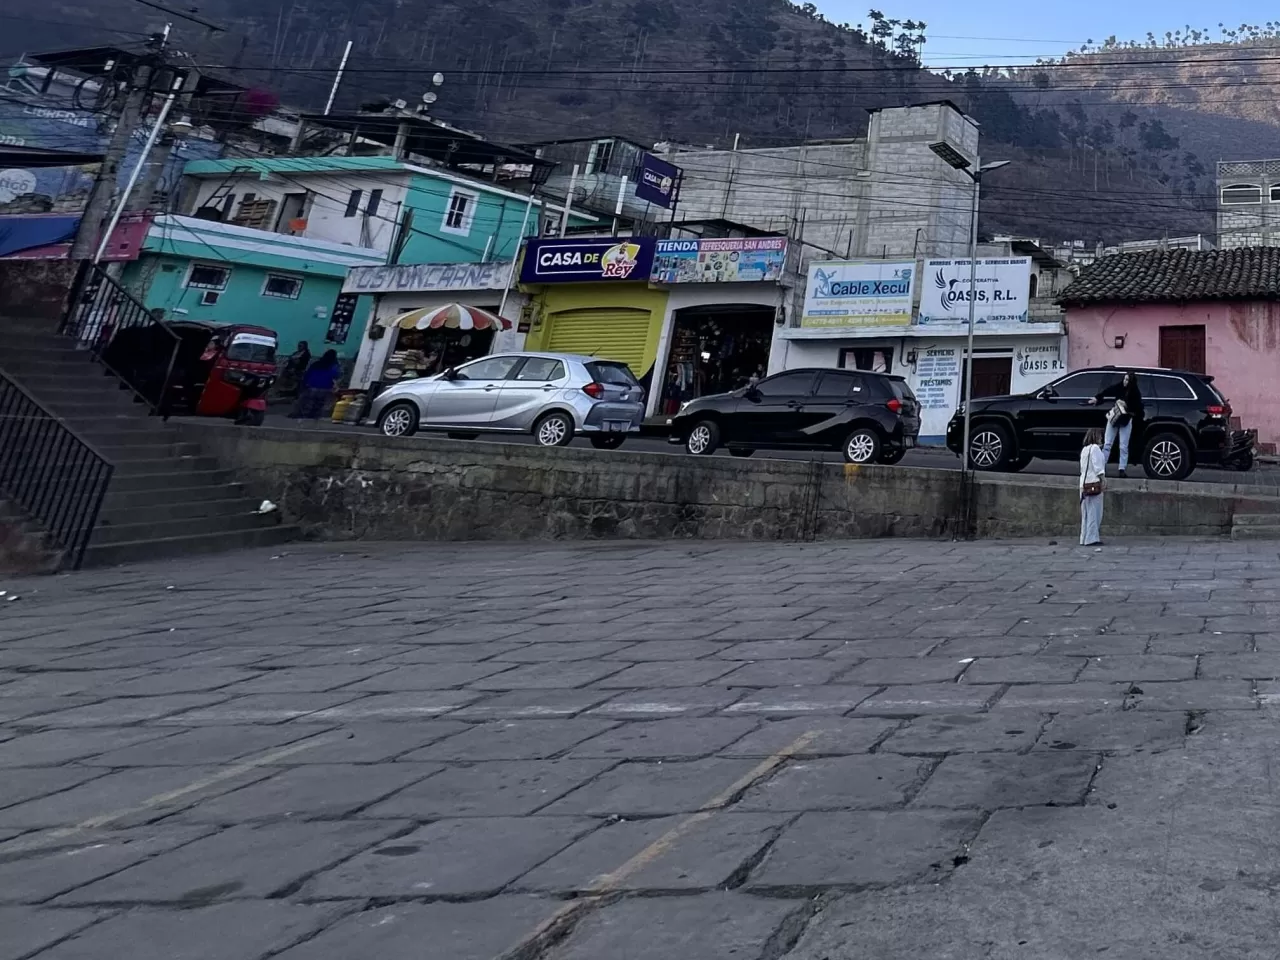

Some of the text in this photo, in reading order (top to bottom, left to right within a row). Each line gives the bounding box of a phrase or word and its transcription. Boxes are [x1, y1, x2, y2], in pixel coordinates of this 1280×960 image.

[658, 241, 698, 252] TIENDA
[744, 240, 759, 250] SAN
[540, 252, 599, 266] CASA DE
[603, 263, 633, 278] Rey
[831, 280, 910, 296] Cable Xecul
[993, 290, 1017, 301] R.L.
[1023, 360, 1048, 370] OASIS
